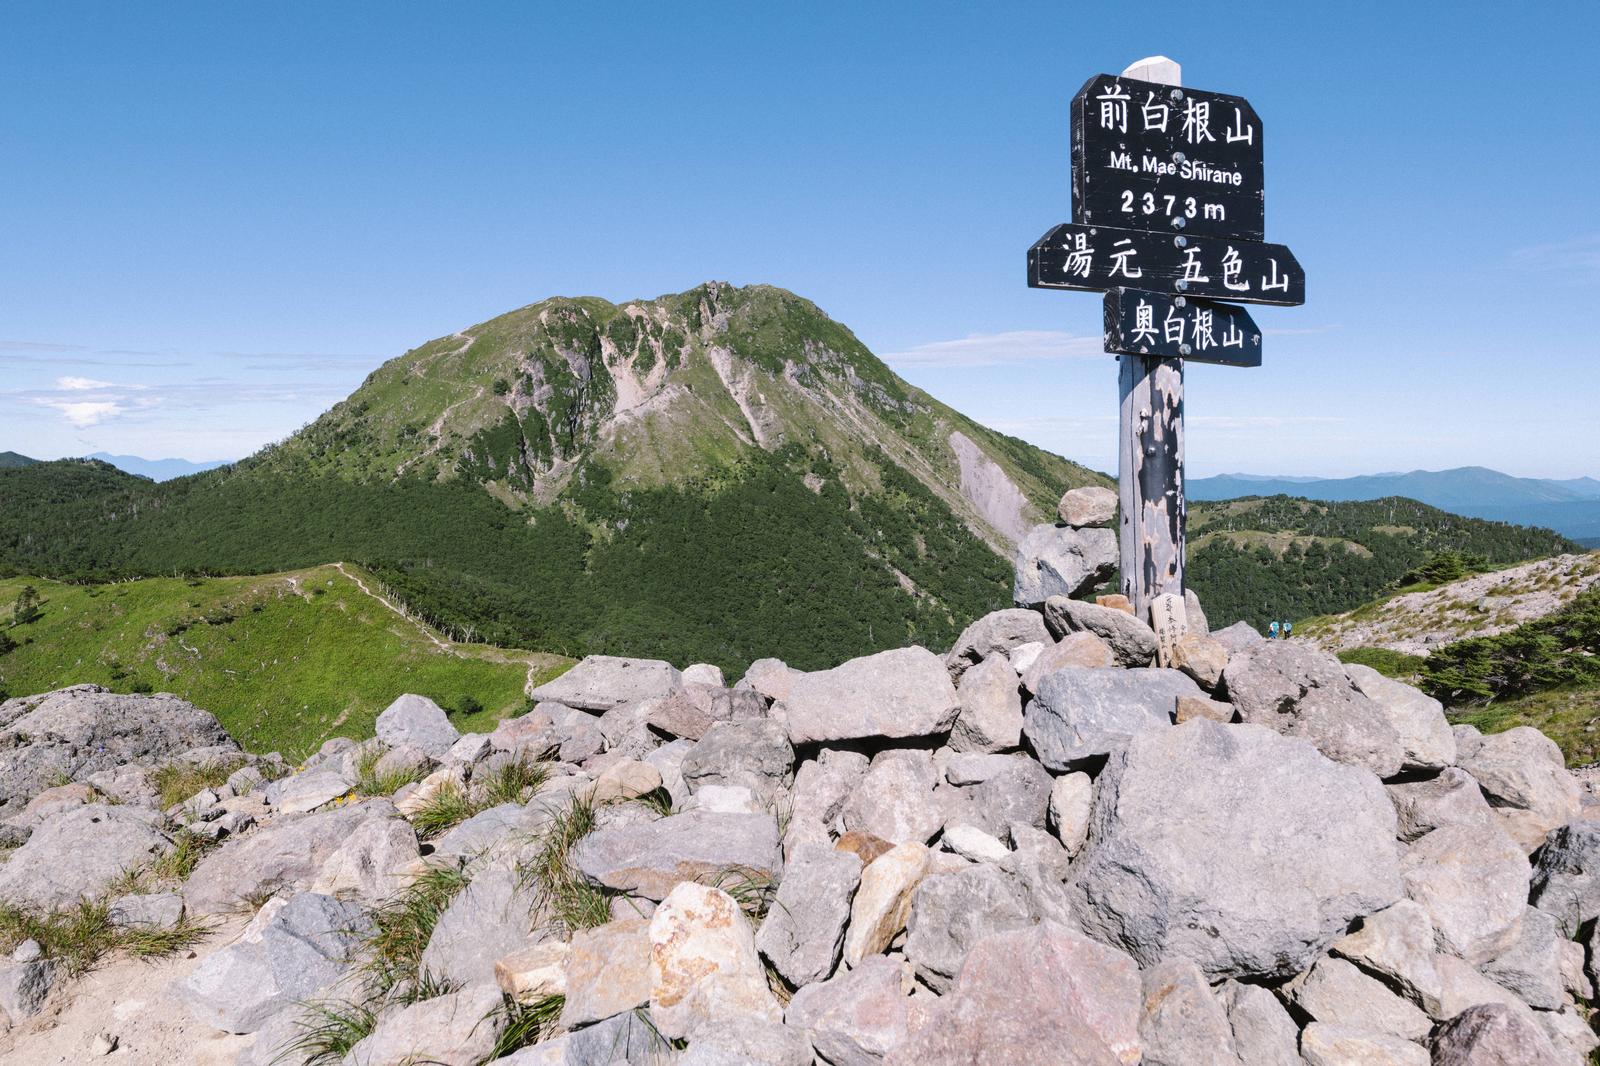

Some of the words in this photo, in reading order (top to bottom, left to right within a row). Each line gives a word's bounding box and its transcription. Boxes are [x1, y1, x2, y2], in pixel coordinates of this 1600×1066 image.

[1096, 85, 1253, 146] 前白根山
[1110, 151, 1139, 173] Mt.
[1142, 155, 1176, 175] Mae
[1180, 160, 1243, 186] Shirane
[1062, 232, 1142, 278] 湯元
[1181, 245, 1289, 292] 五色山
[1131, 298, 1243, 351] 奥白根山
